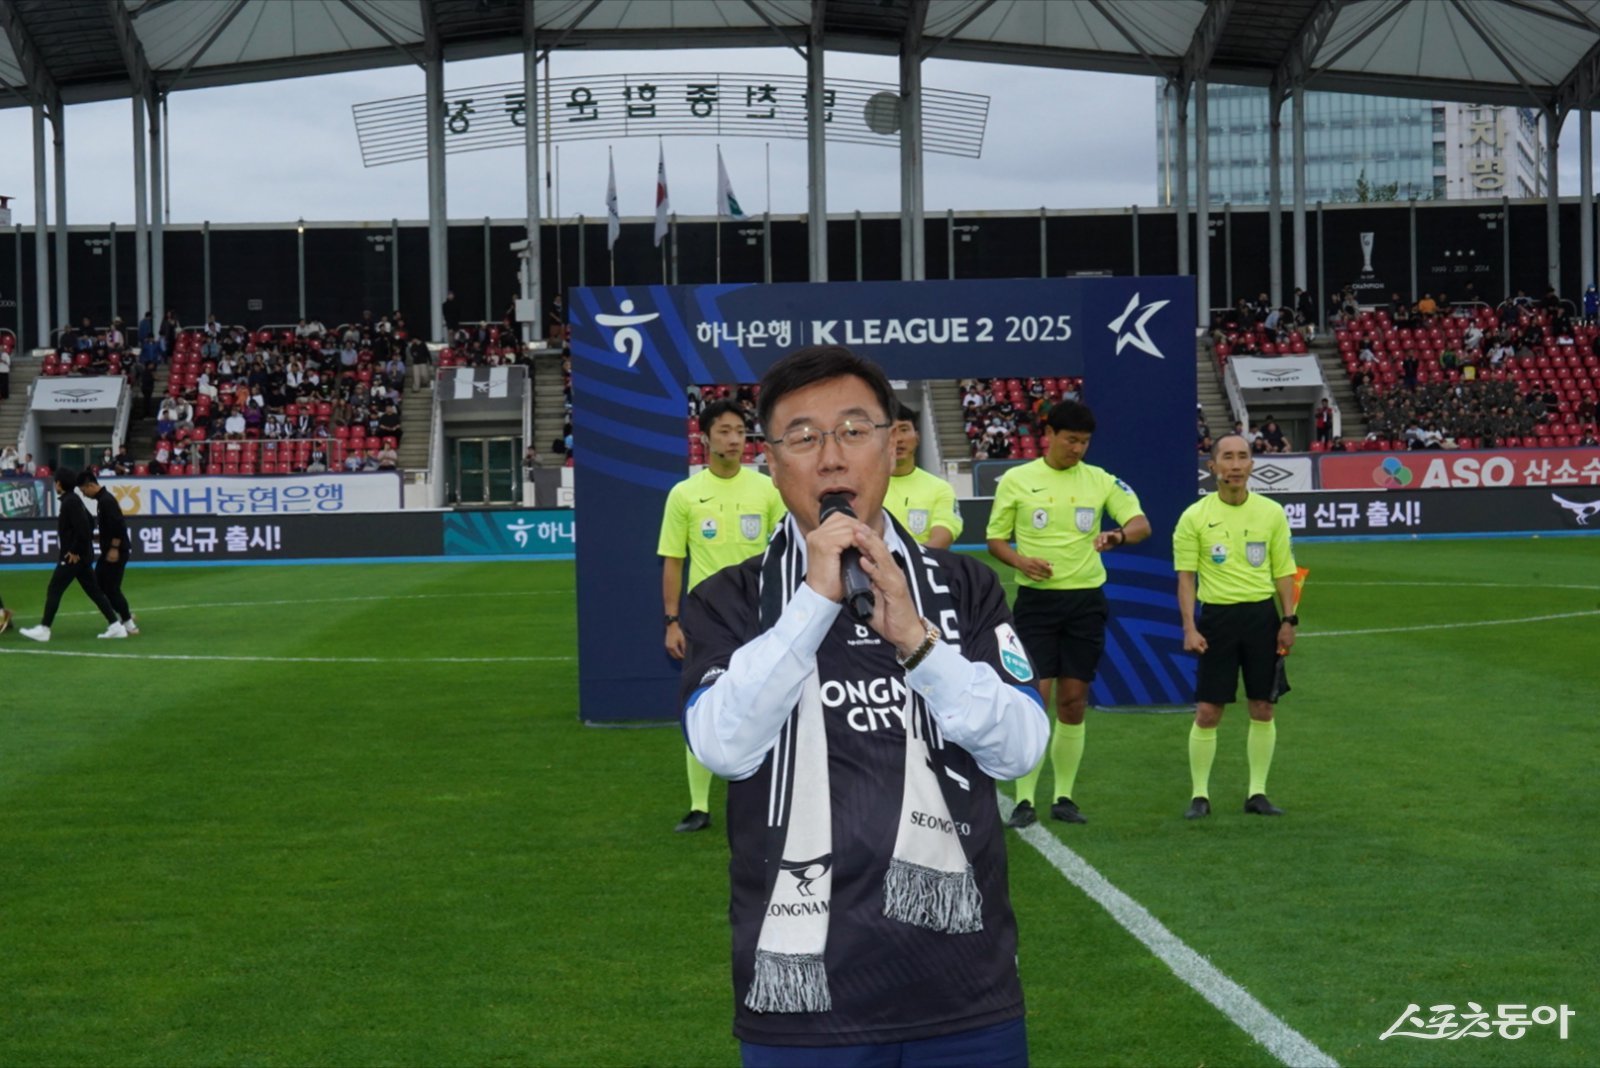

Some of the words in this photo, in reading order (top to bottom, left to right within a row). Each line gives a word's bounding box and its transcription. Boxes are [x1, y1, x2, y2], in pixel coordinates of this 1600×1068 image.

[1466, 104, 1508, 190] 차병
[696, 320, 792, 348] 하나은행
[811, 320, 839, 345] K
[844, 317, 970, 345] LEAGUE
[975, 317, 994, 342] 2
[1005, 315, 1072, 342] 2025
[1420, 456, 1515, 488] ASO
[1523, 457, 1600, 486] 산소수
[149, 483, 344, 515] NH농협은행
[1313, 502, 1360, 528] 신규
[1366, 500, 1420, 527] 출시!
[0, 529, 61, 555] 성남F
[139, 527, 163, 553] 앱
[170, 527, 219, 552] 신규
[224, 525, 281, 552] 출시!
[847, 705, 907, 732] CITY
